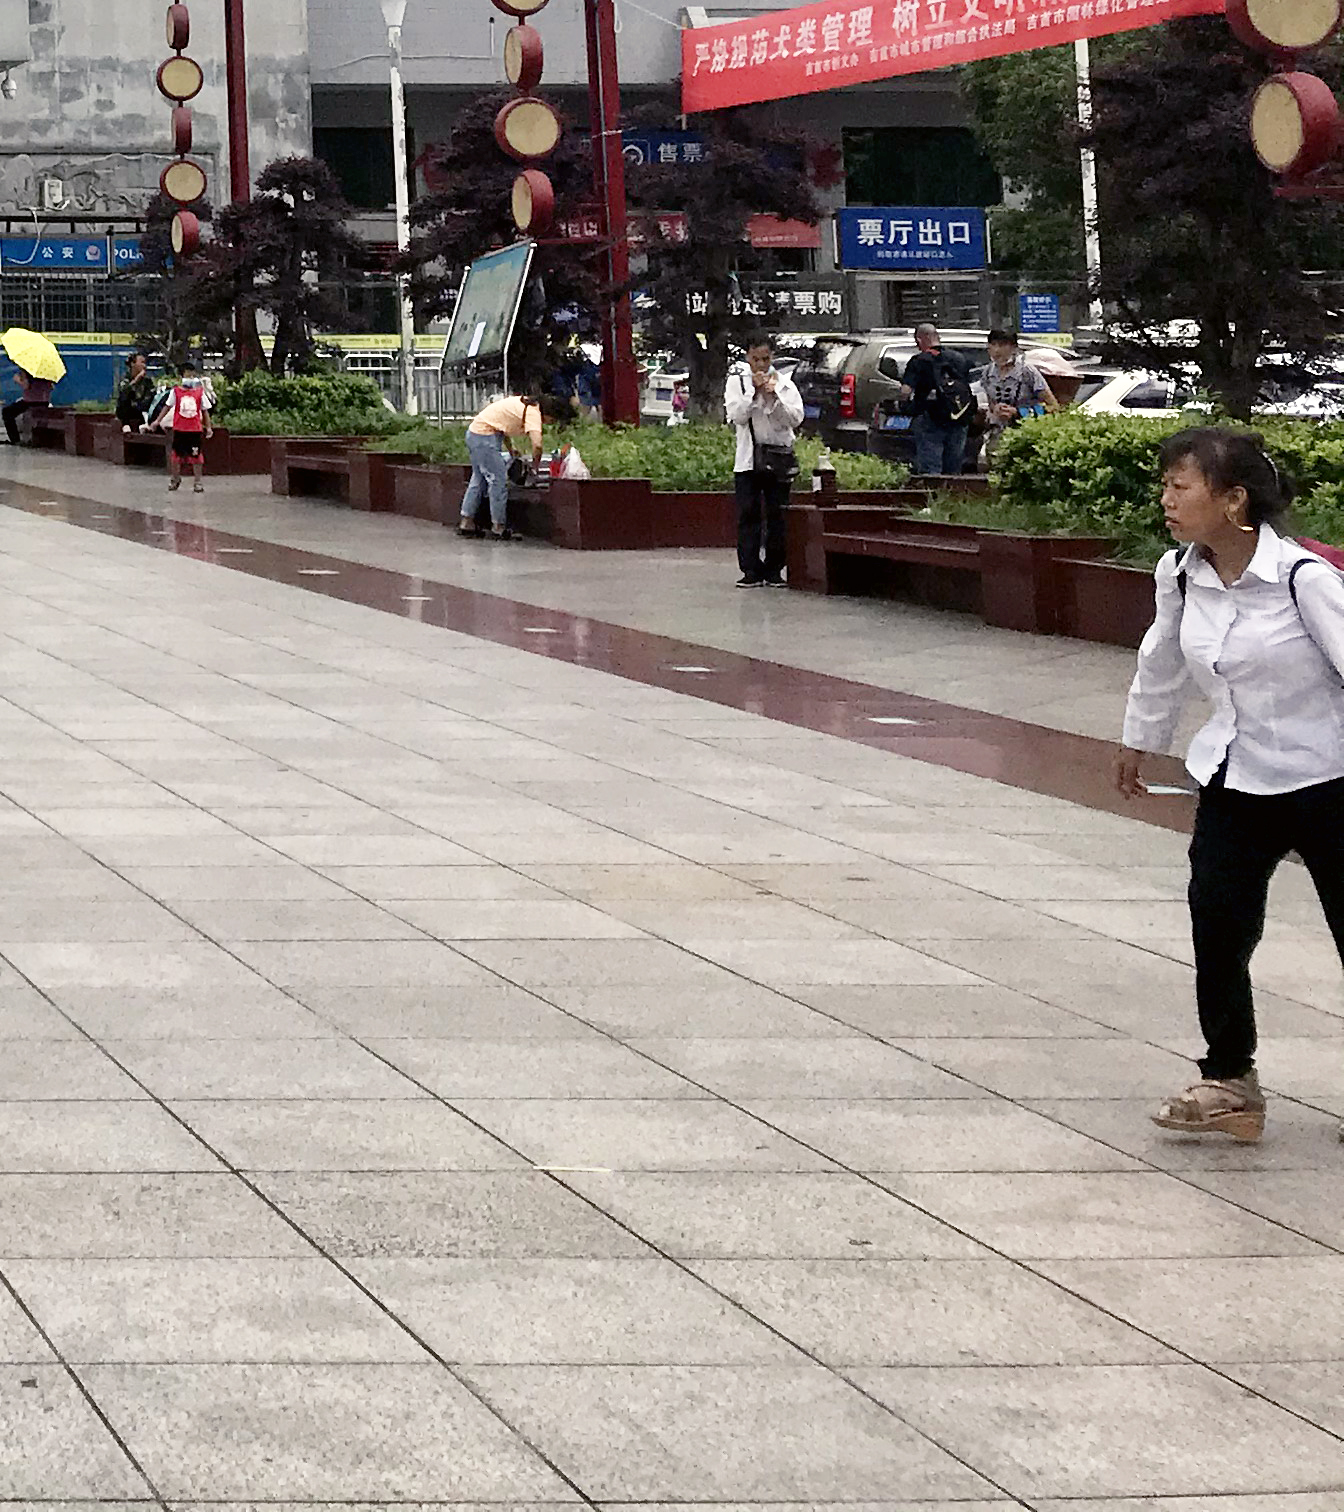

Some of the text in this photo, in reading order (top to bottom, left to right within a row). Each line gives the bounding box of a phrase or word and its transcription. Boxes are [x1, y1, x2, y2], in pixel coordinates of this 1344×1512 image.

[657, 142, 703, 163] 售票
[857, 218, 971, 246] 票厅出口
[41, 246, 74, 259] 公安
